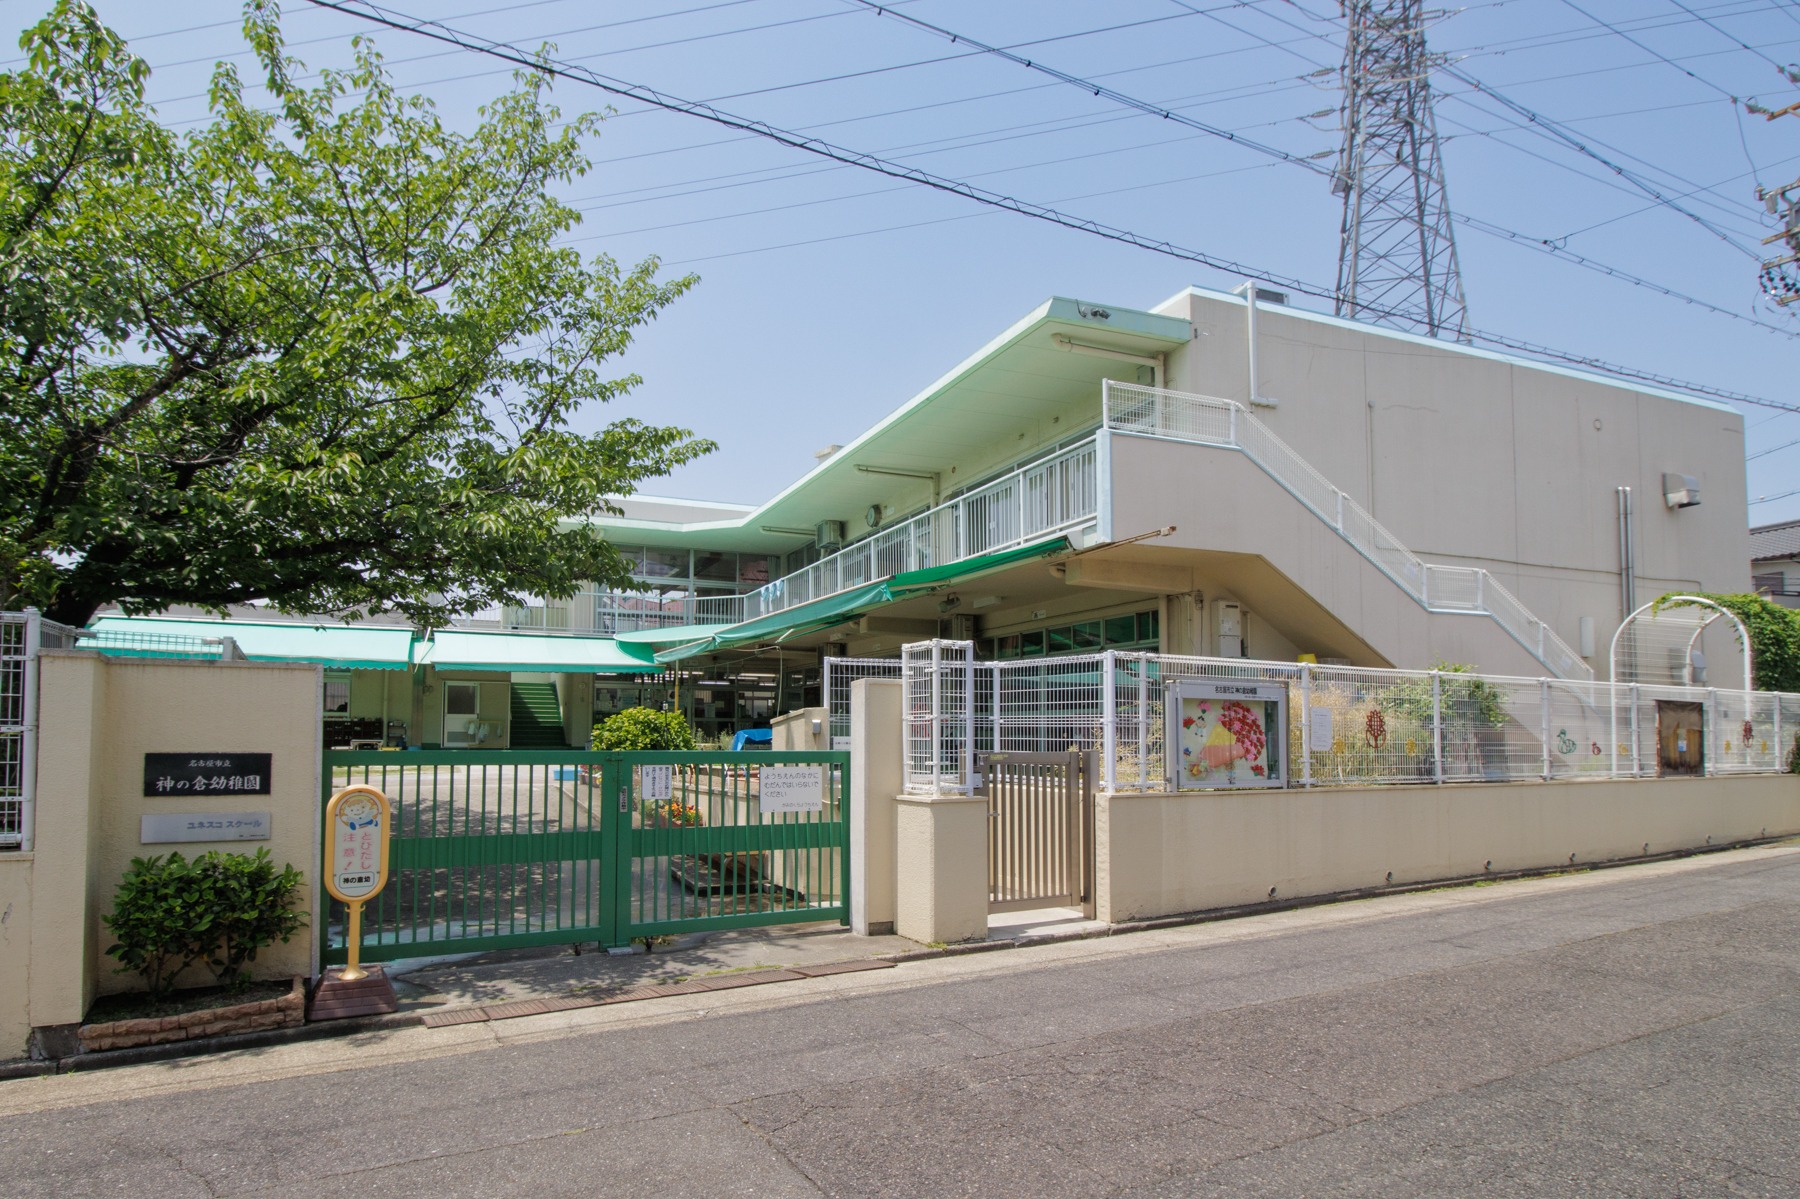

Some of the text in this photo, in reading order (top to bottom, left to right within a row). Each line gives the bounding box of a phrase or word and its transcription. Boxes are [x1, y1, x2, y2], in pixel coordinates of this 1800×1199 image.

[188, 759, 232, 768] 名古屋市立
[764, 772, 819, 780] ようちえんのなかに
[156, 775, 261, 792] 神の倉幼稚園
[764, 781, 819, 789] むだんではいらないで
[187, 821, 223, 830] ユネスコ
[360, 831, 372, 870] とびだし
